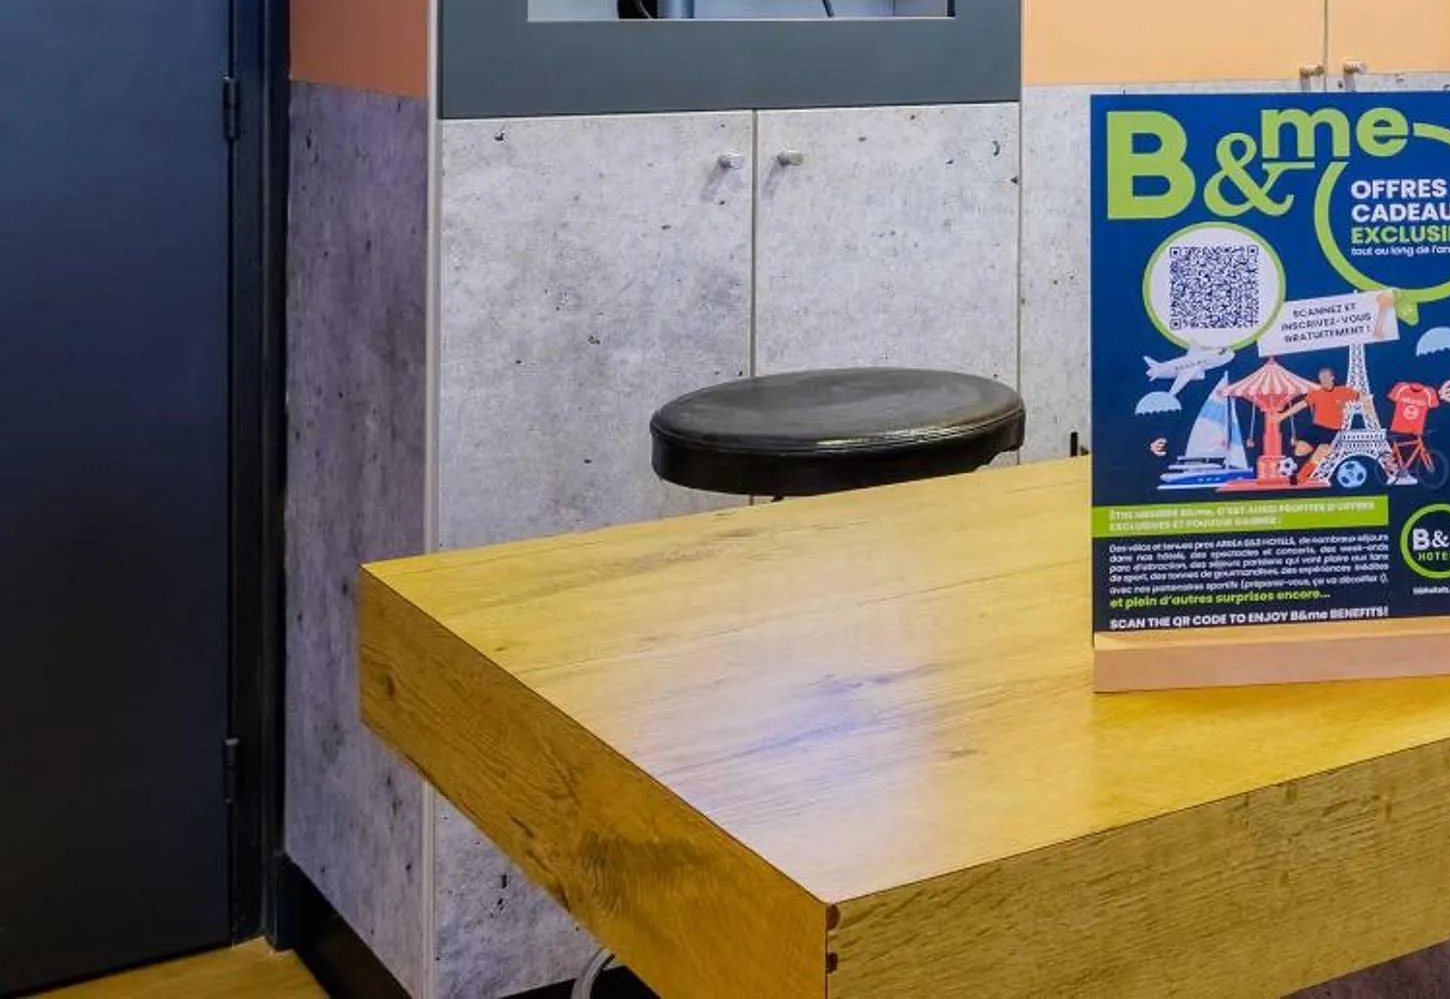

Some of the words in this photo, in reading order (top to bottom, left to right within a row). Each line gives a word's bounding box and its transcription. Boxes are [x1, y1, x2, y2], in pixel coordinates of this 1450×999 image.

[1351, 179, 1447, 200] OFFRES
[1351, 246, 1372, 256] tout
[1374, 247, 1389, 255] au
[1390, 244, 1414, 257] long
[1416, 244, 1430, 254] de
[1293, 304, 1342, 319] SCANNEZ
[1281, 312, 1372, 331] INSCRIVEZ-VOUS
[1284, 326, 1365, 342] GRATUITEMENT
[1110, 597, 1124, 608] et
[1125, 595, 1157, 610] plein
[1159, 595, 1213, 605] d'autres
[1215, 591, 1274, 605] surprises
[1110, 617, 1145, 629] SCAN
[1148, 616, 1170, 627] THE
[1173, 615, 1190, 627] QR
[1193, 614, 1226, 625] CODE
[1229, 613, 1246, 624] TO
[1248, 611, 1288, 623] ENJOY
